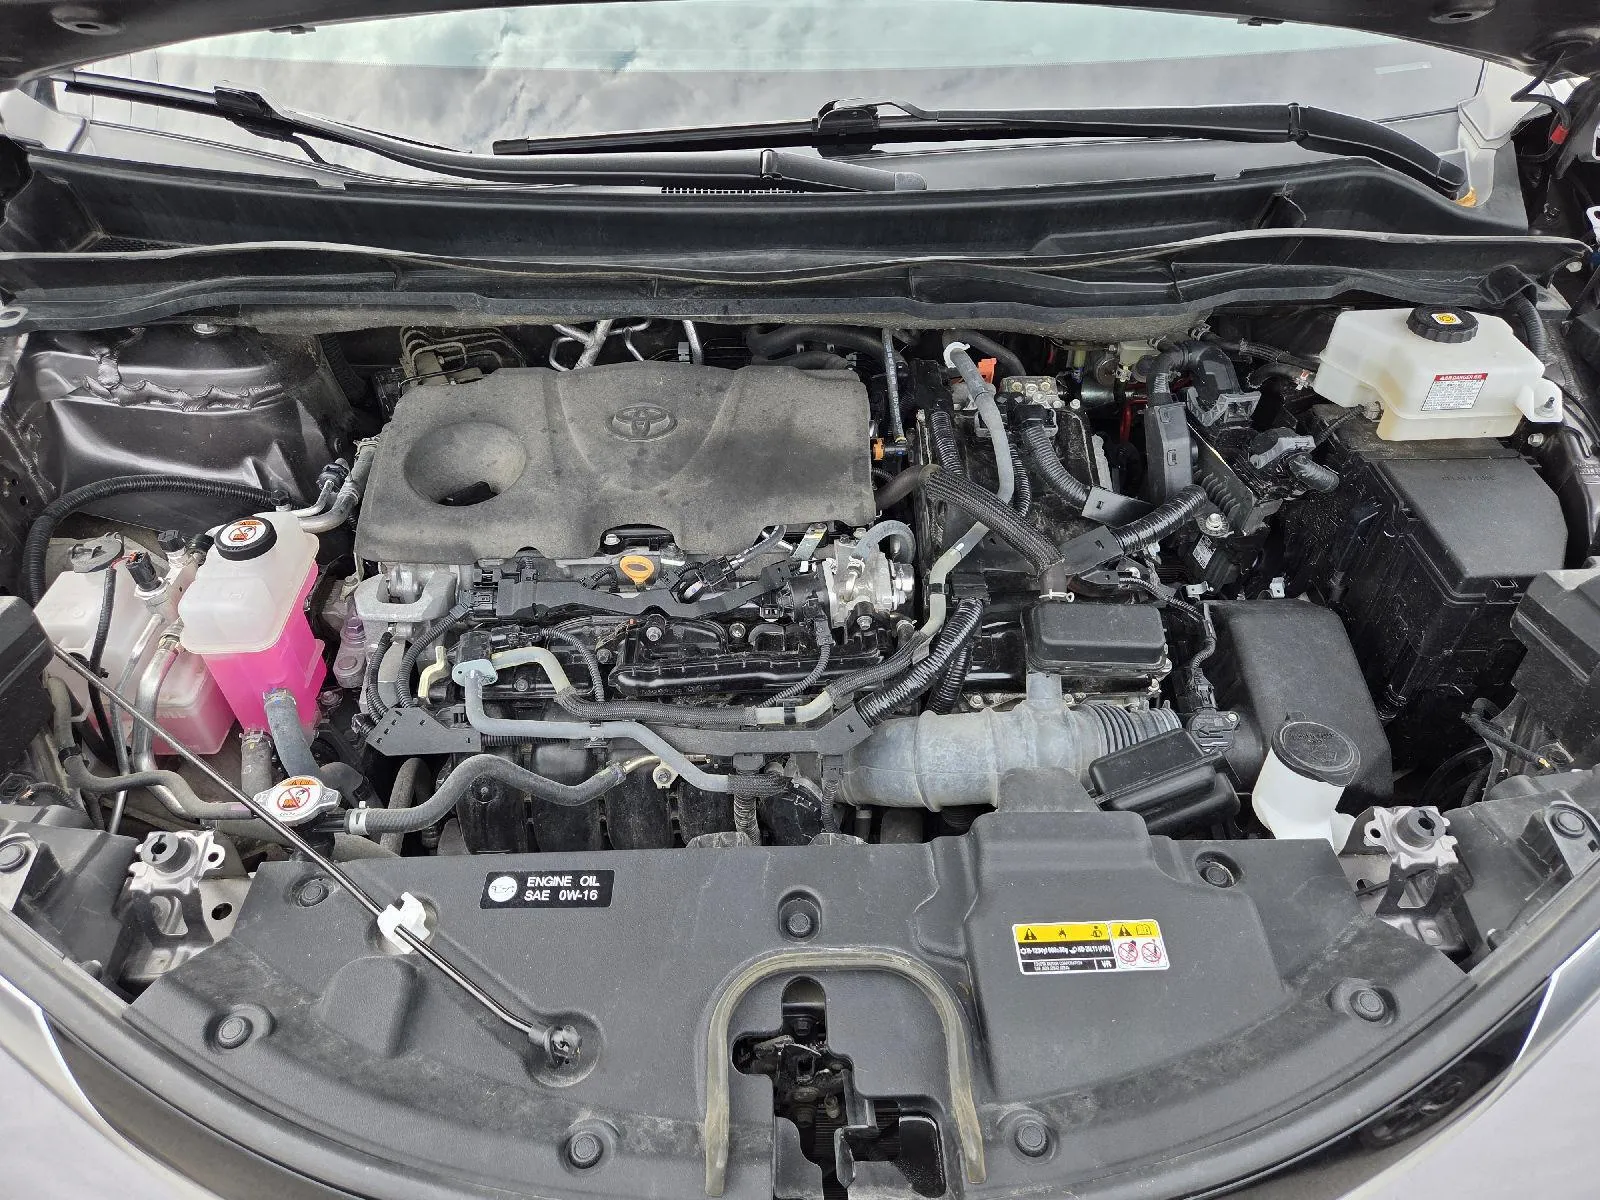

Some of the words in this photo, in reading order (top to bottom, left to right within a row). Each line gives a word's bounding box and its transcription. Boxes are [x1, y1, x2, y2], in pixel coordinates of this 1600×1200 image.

[526, 876, 573, 887] ENGINE
[579, 875, 600, 887] OIL
[524, 889, 551, 901] SAE
[558, 889, 598, 901] 0W-16
